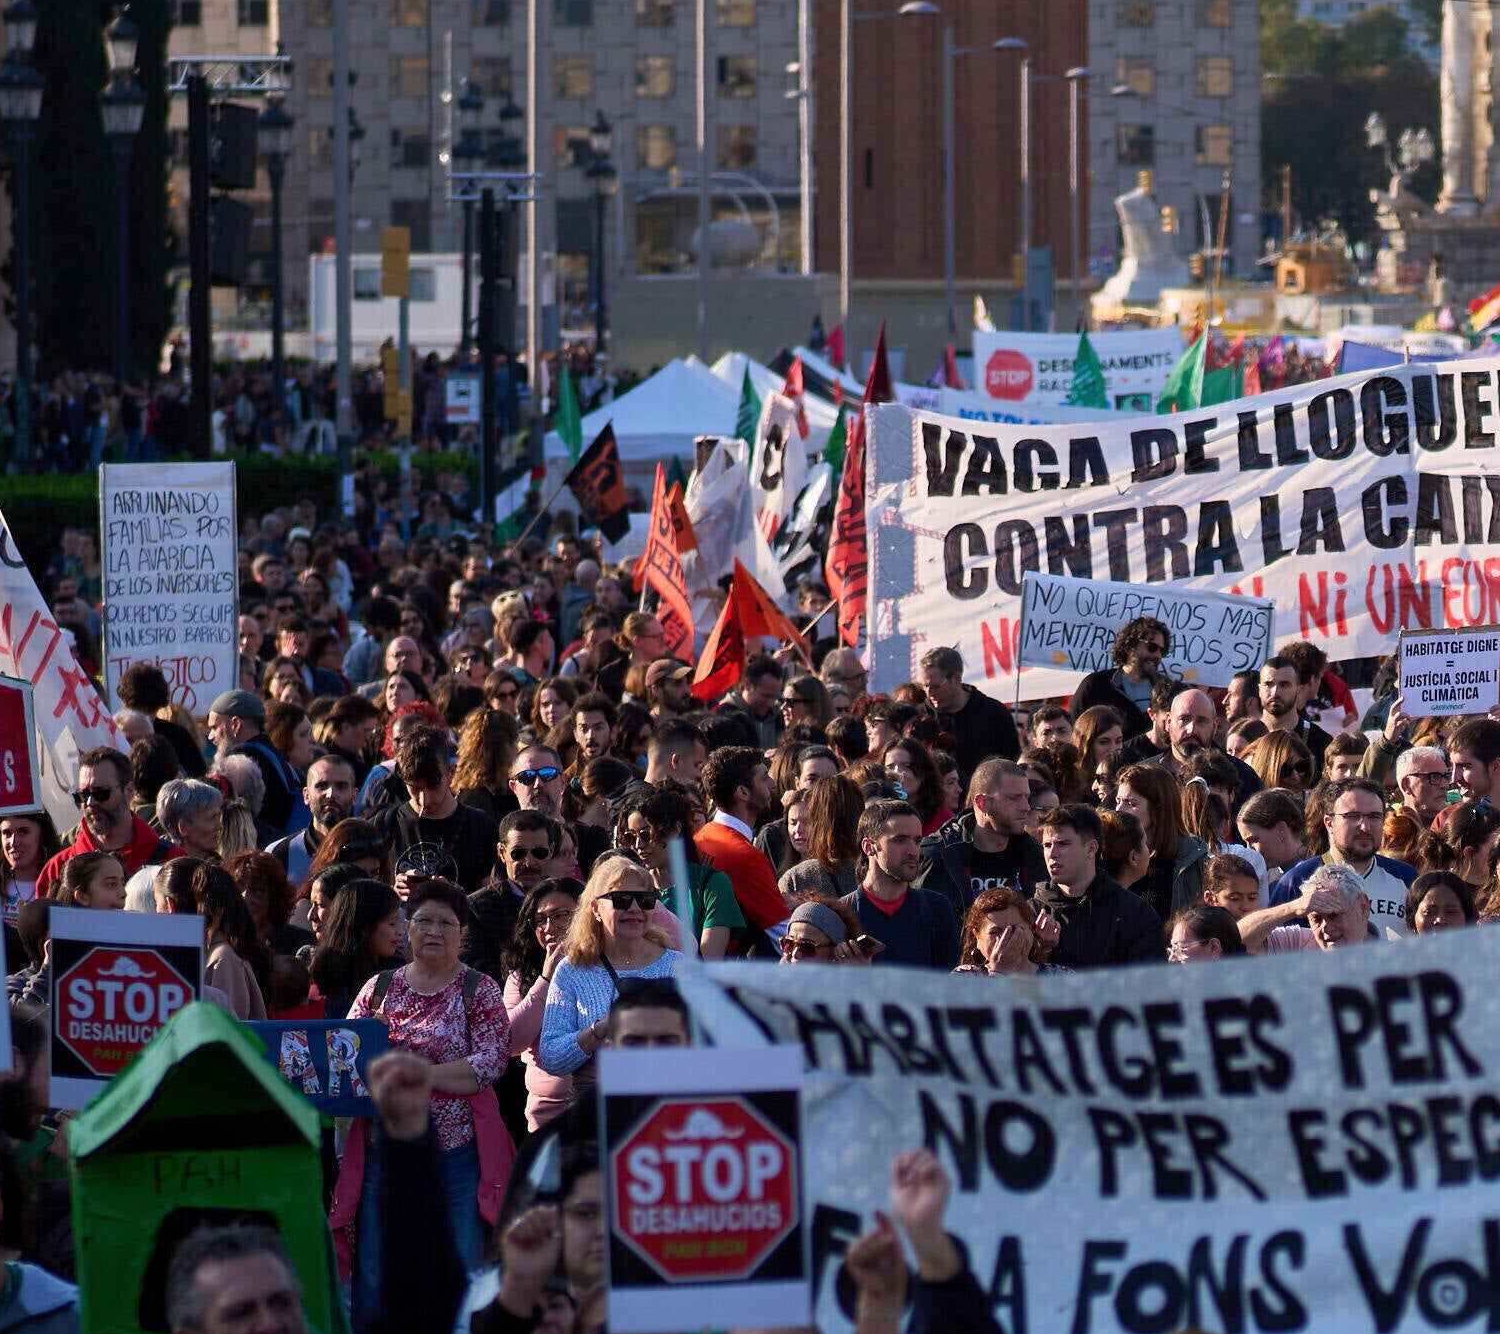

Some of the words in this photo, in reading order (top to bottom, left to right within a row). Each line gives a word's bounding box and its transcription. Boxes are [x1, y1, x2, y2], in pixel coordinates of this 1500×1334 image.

[989, 369, 1031, 386] STOP
[922, 422, 1110, 498] VAGA
[1131, 418, 1220, 483] DE
[113, 489, 219, 516] ARRUINANDO
[108, 516, 188, 546] FAMILIAS
[195, 515, 231, 540] POR
[943, 499, 1244, 600] CONTRA
[1260, 486, 1346, 567] LA
[109, 549, 131, 574] LA
[138, 544, 215, 574] AVARICIA
[107, 578, 125, 598] DE
[129, 575, 152, 595] LOS
[156, 571, 234, 595] INVERSORES
[1366, 558, 1428, 637] UN
[107, 603, 177, 625] QUEREMOS
[182, 603, 234, 625] SEGUIR
[1032, 581, 1066, 615] NO
[1075, 586, 1208, 632] QUEREMOS
[125, 626, 177, 646] NUESTRO
[184, 628, 231, 645] BARRIO
[1024, 618, 1117, 650] MENTIRA
[1405, 640, 1465, 658] HABITATGE
[1467, 638, 1499, 654] DIGNE
[1404, 670, 1456, 689] JUSTÍCIA
[1458, 669, 1491, 686] SOCIAL
[1421, 686, 1480, 703] CLIMÀTICA
[1369, 899, 1406, 919] KEES
[67, 978, 194, 1022] STOP
[67, 1020, 156, 1045] DESAHUCI
[1204, 994, 1292, 1098] ES
[1326, 970, 1484, 1089] PER
[918, 1089, 1057, 1194] NO
[1087, 1108, 1268, 1202] PER
[154, 1153, 241, 1194] PAH
[626, 1142, 786, 1207] STOP
[629, 1201, 783, 1235] DESAHUCIOS
